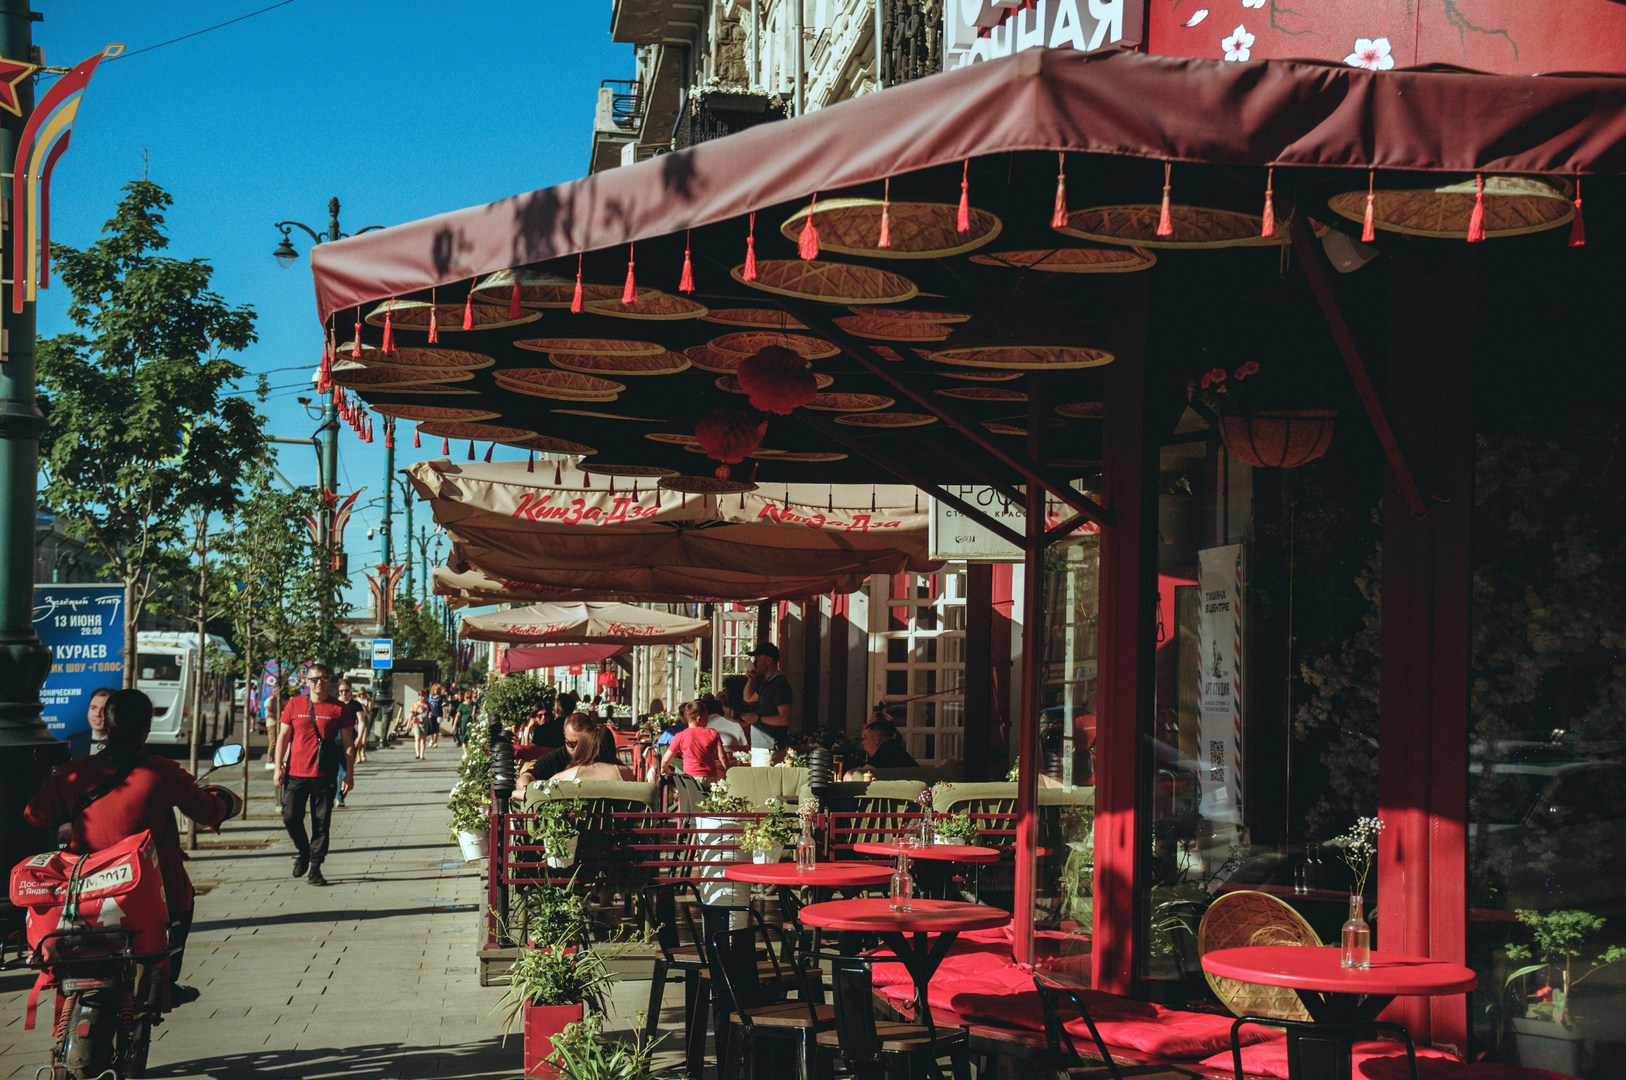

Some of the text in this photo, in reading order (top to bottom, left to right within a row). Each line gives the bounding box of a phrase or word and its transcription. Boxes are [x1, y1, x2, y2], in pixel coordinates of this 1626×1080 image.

[54, 614, 102, 627] 13 ИЮНЯ
[80, 627, 102, 635] 20:00
[56, 644, 107, 659] КУРАЕВ
[66, 662, 86, 673] ШОУ
